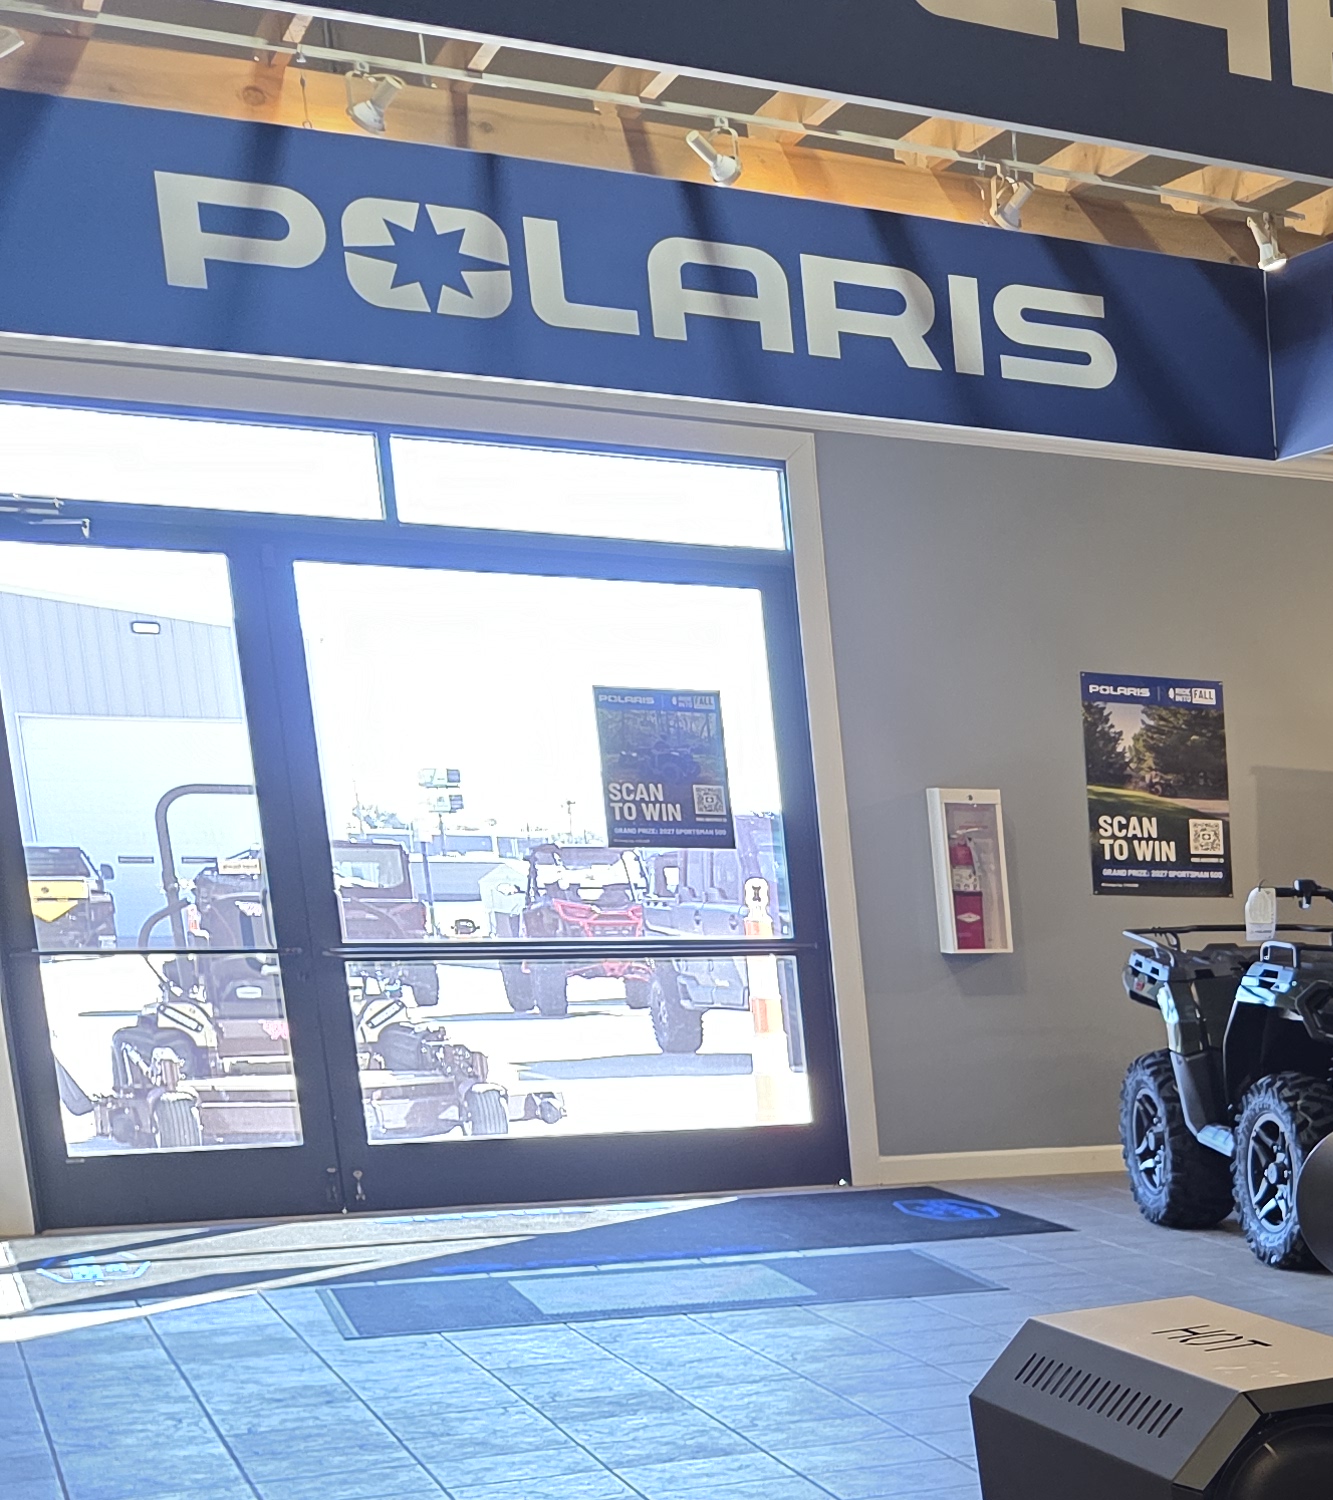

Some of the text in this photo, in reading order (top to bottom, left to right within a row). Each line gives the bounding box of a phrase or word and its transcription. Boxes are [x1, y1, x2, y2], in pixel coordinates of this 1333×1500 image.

[155, 170, 1118, 389] POLARIS
[598, 694, 655, 705] POLARIS
[1089, 684, 1151, 697] POLARIS
[1193, 689, 1214, 701] FALL
[608, 782, 664, 802] SCAN
[610, 802, 682, 822] TO WIN
[1098, 815, 1158, 838] SCAN
[1099, 839, 1177, 862] TO WIN
[1151, 1324, 1272, 1352] HOT
